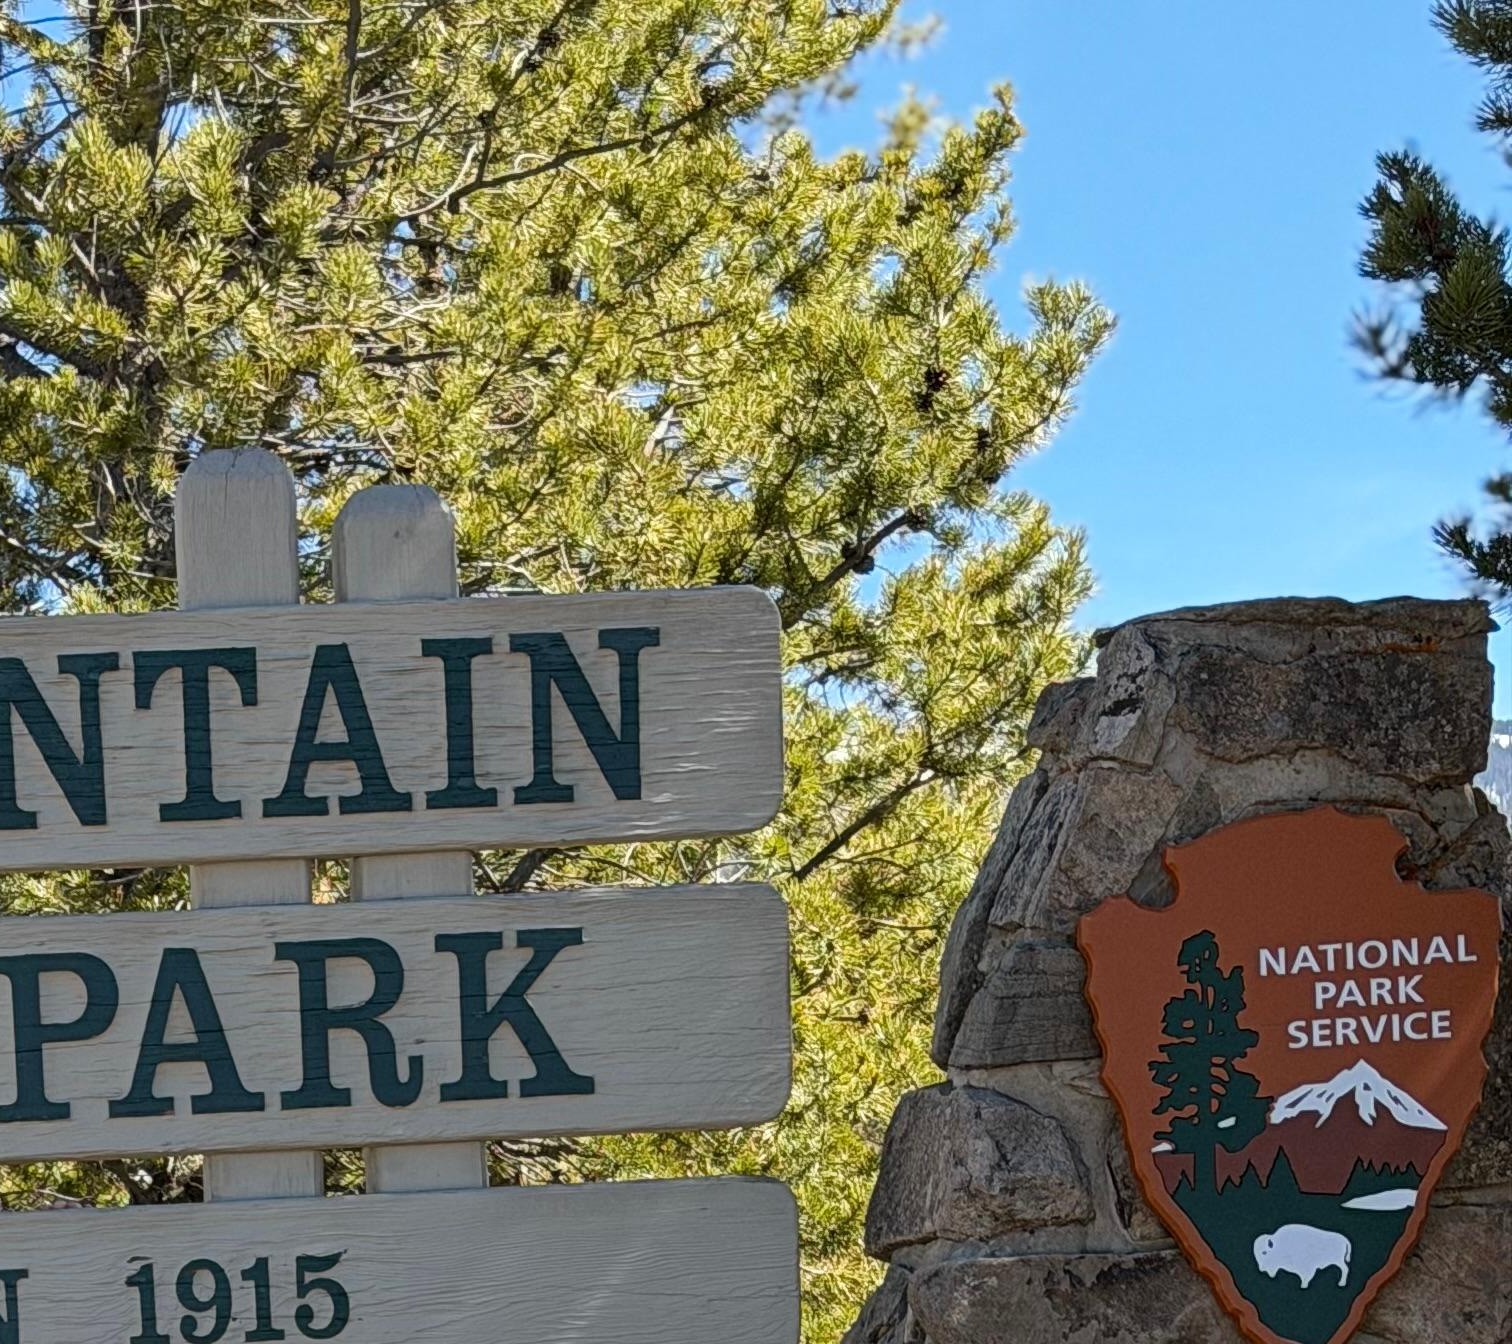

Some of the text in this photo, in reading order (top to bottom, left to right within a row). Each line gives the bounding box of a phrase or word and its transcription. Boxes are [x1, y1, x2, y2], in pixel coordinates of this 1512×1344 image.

[1258, 933, 1478, 977] NATIONAL
[1314, 974, 1425, 1010] PARK
[1286, 1010, 1453, 1049] SERVICE
